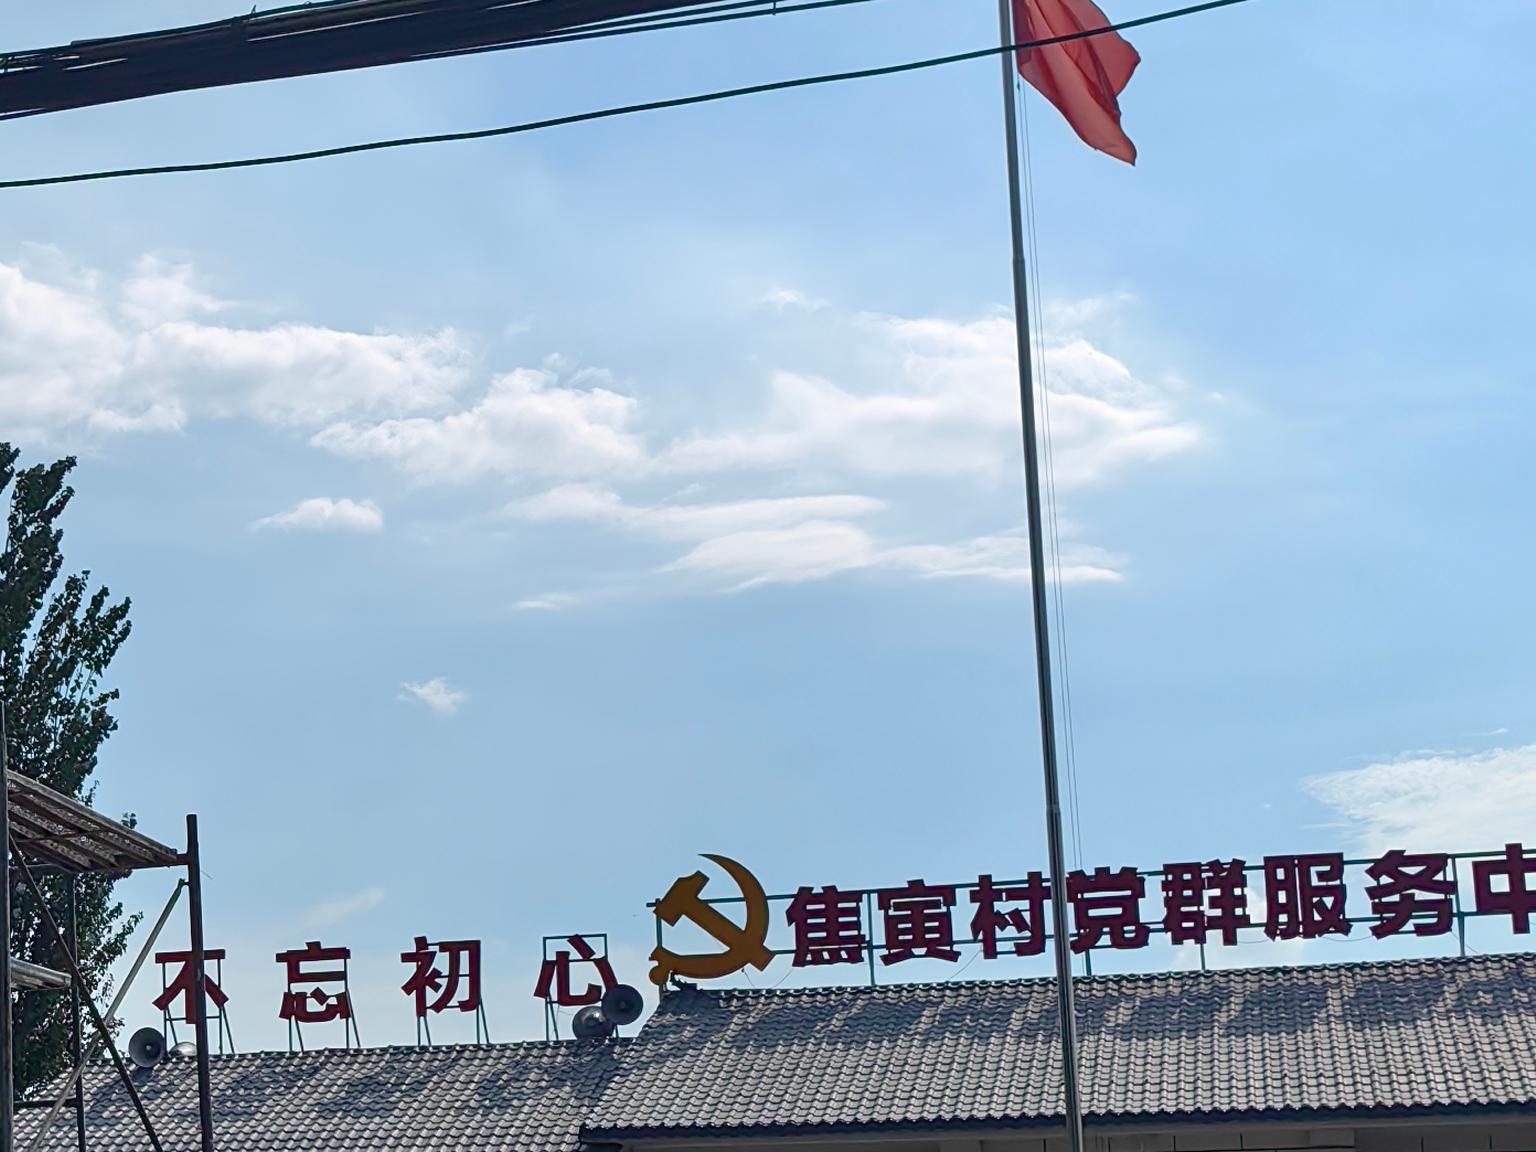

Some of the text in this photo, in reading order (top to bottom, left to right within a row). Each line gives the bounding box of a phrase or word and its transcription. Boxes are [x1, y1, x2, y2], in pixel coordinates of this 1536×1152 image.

[786, 843, 1536, 967] 焦寅村党群服务中
[154, 935, 616, 1024] 不忘初心
